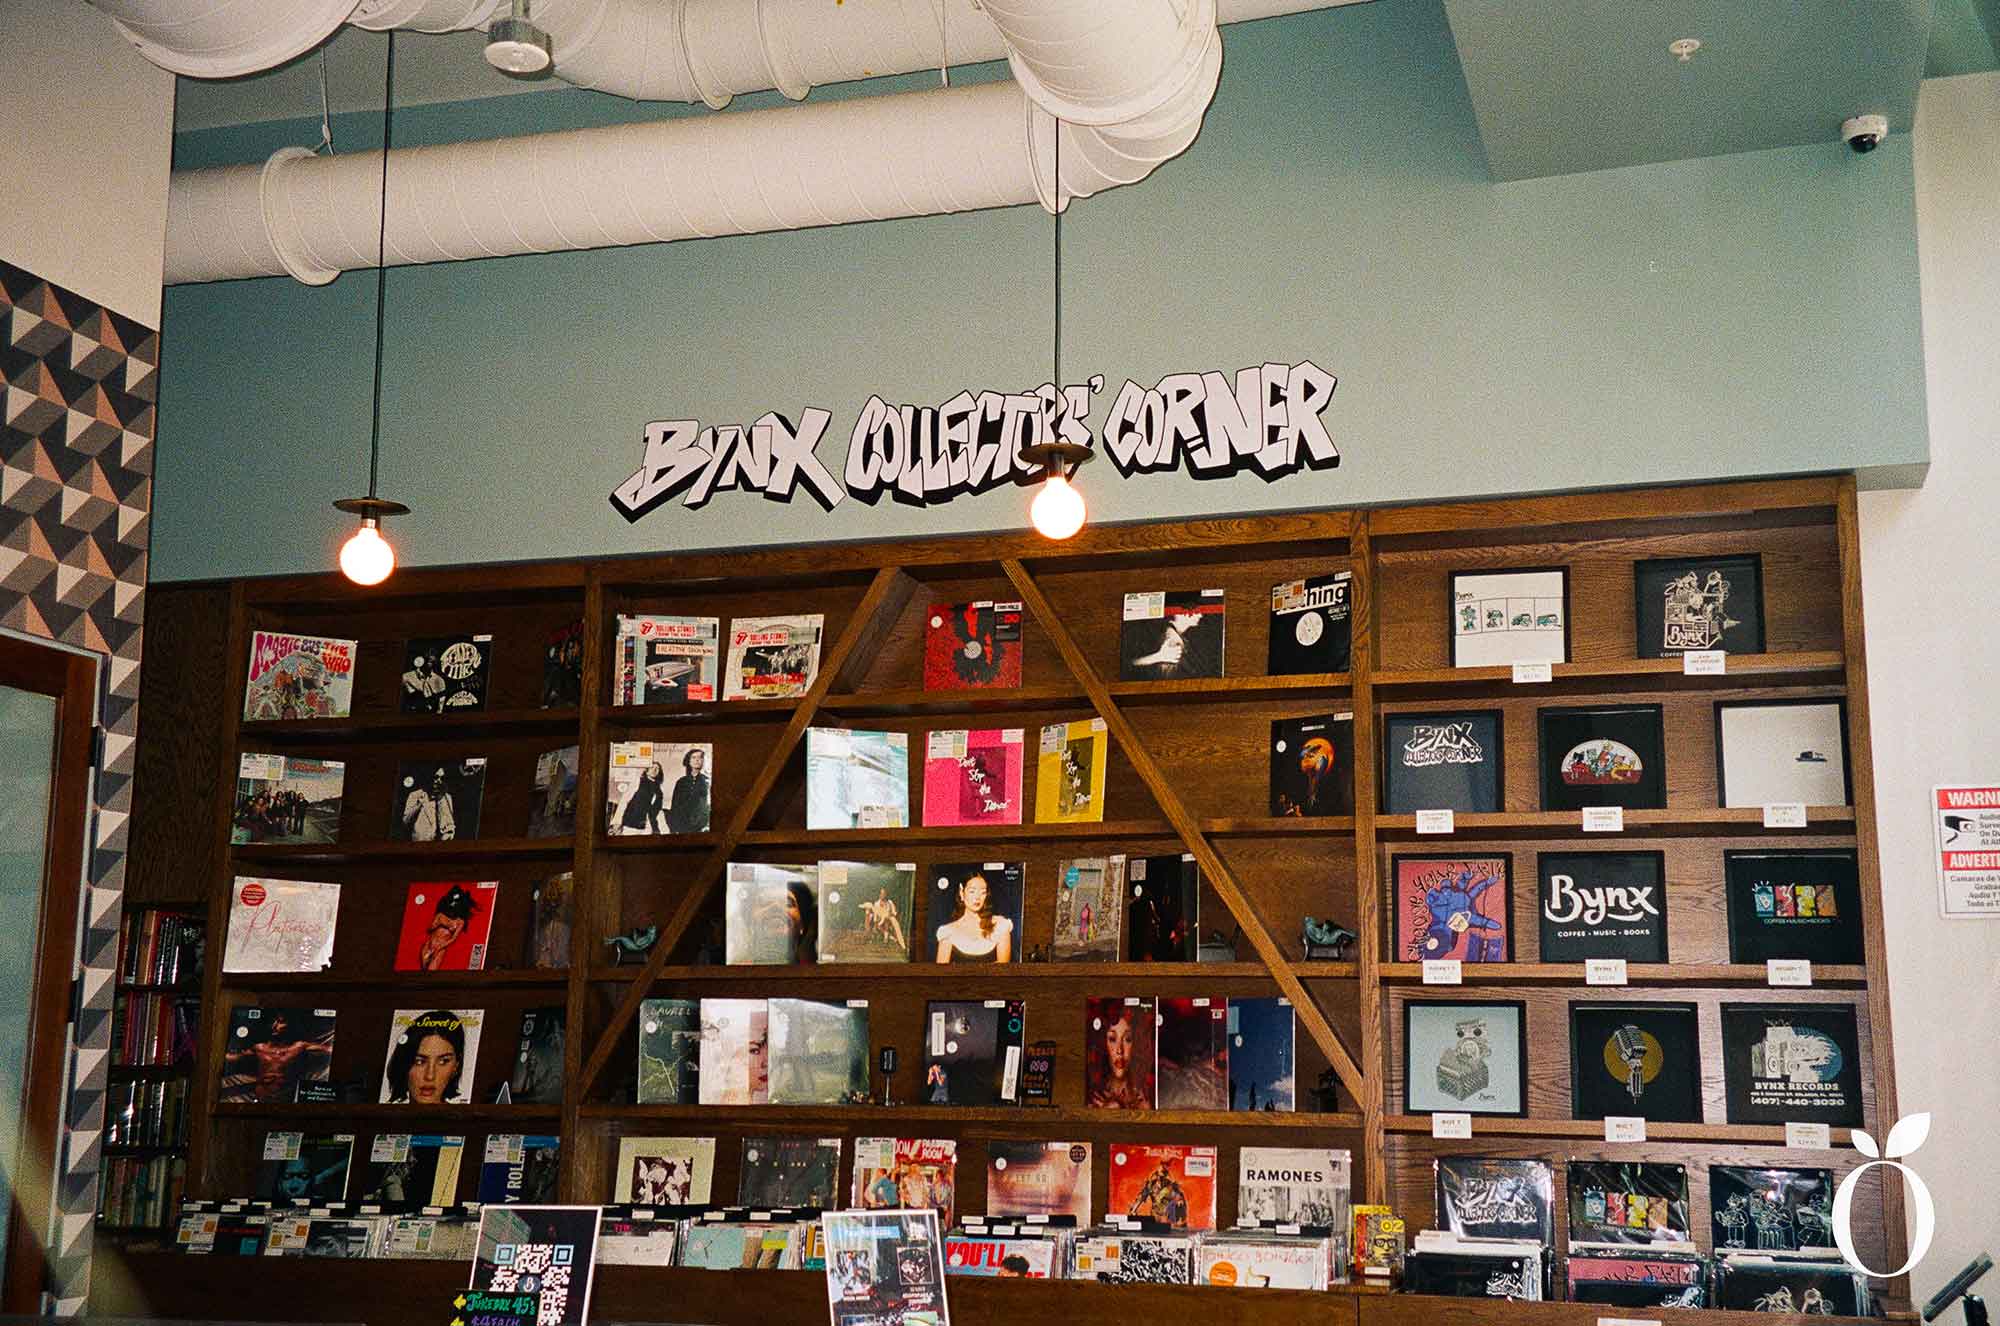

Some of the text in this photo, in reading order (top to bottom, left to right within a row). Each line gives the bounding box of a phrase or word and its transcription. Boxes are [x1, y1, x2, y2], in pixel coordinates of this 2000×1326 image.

[609, 407, 846, 523] BYNX
[1098, 360, 1340, 484] CORNER
[1668, 626, 1706, 646] Bynx
[322, 641, 347, 656] THE
[322, 652, 351, 672] WHO
[1404, 722, 1480, 752] BYNX
[1545, 875, 1659, 925] Bynx
[416, 1016, 450, 1028] Secret
[448, 1019, 463, 1031] of
[1755, 1082, 1840, 1091] BYNX RECORDS
[1247, 1169, 1323, 1183] RAMONES
